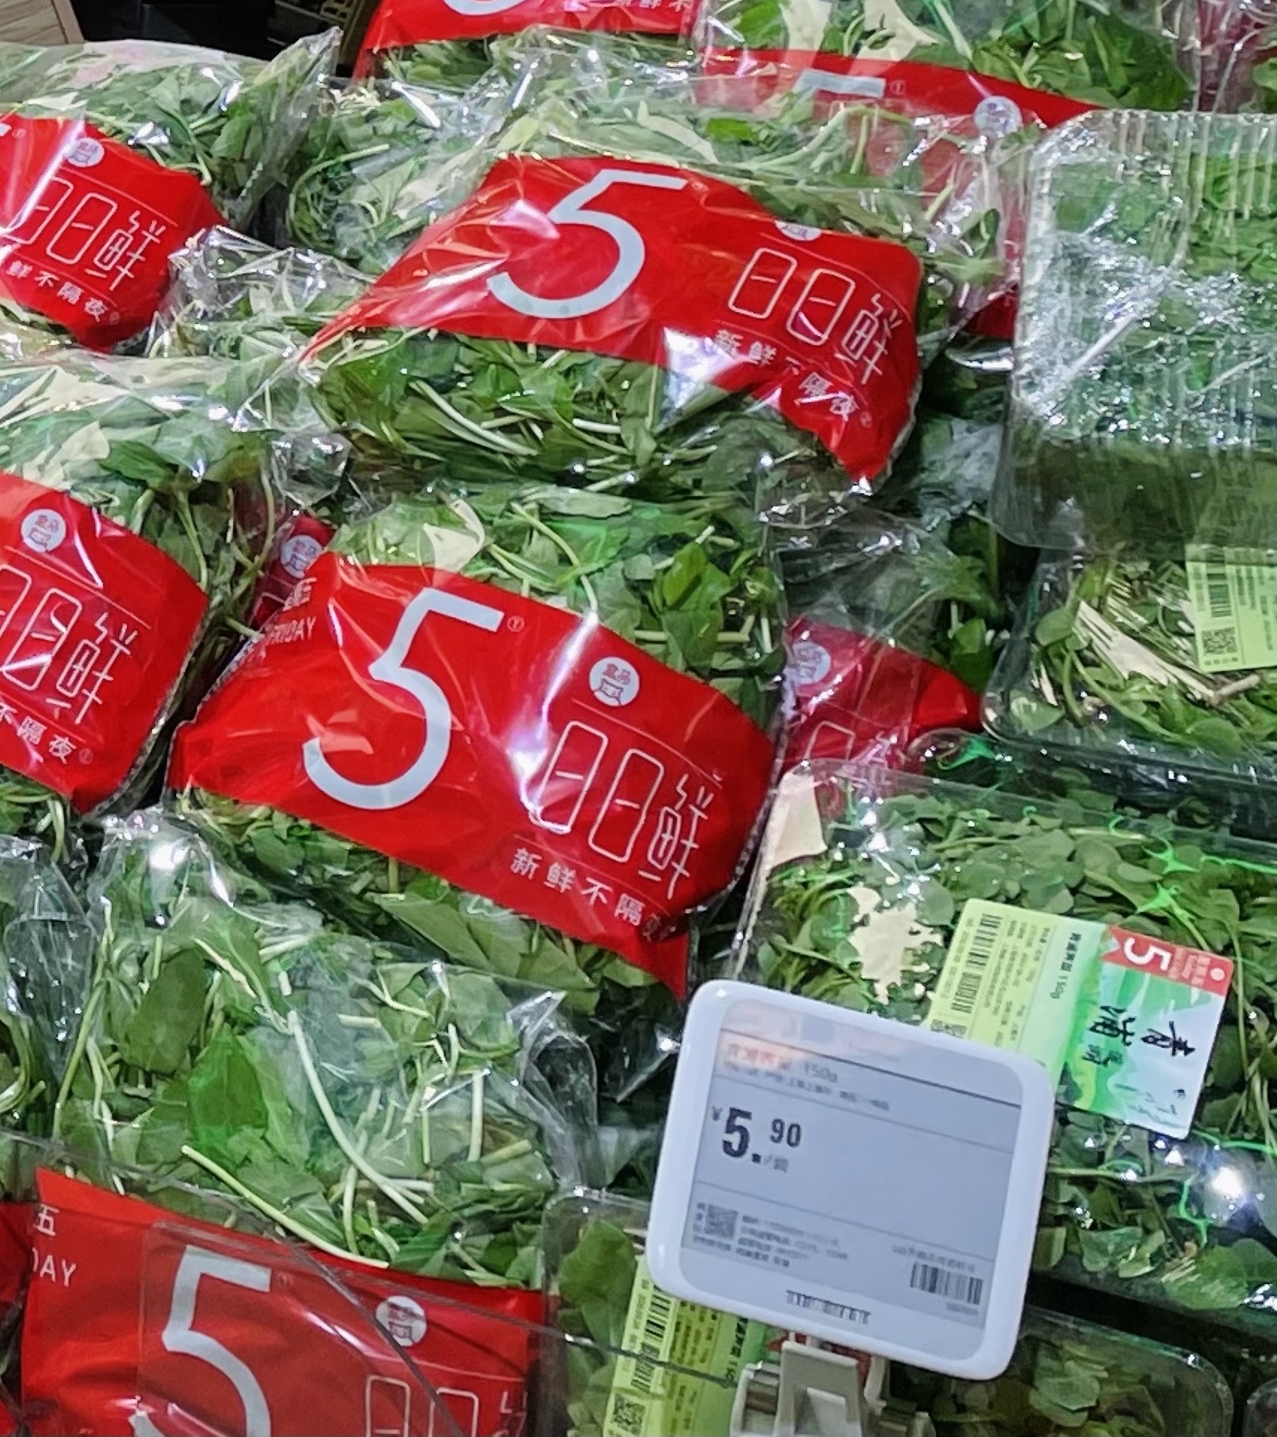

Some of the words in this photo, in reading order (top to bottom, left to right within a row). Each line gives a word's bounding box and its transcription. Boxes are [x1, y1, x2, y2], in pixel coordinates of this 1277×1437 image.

[486, 168, 689, 319] 5
[727, 246, 904, 385] 日日鲜
[303, 586, 505, 811] 5
[528, 720, 715, 901] 日日鲜
[1123, 937, 1172, 971] 5
[129, 1243, 272, 1437] 5
